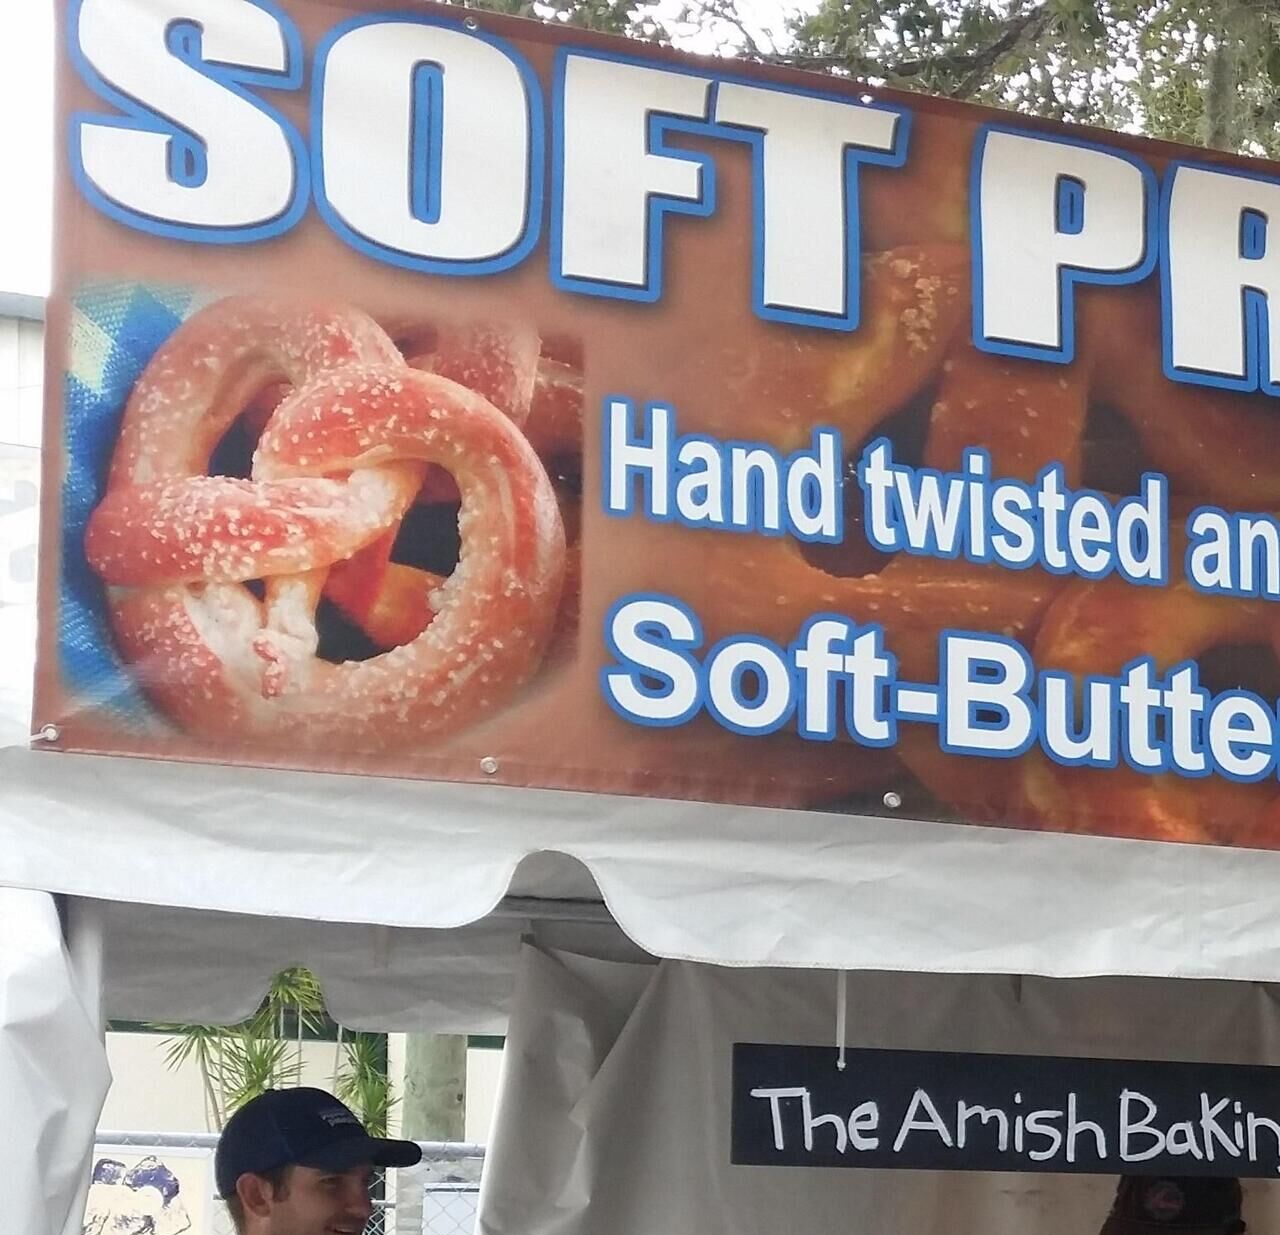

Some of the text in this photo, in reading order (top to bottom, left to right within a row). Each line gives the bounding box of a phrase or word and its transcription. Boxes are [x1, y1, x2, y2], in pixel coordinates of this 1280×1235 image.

[74, 0, 908, 328] SOFT
[605, 398, 839, 540] Hand
[861, 438, 1167, 583] twisted
[749, 1086, 880, 1155] The
[892, 1088, 1108, 1164] Amish
